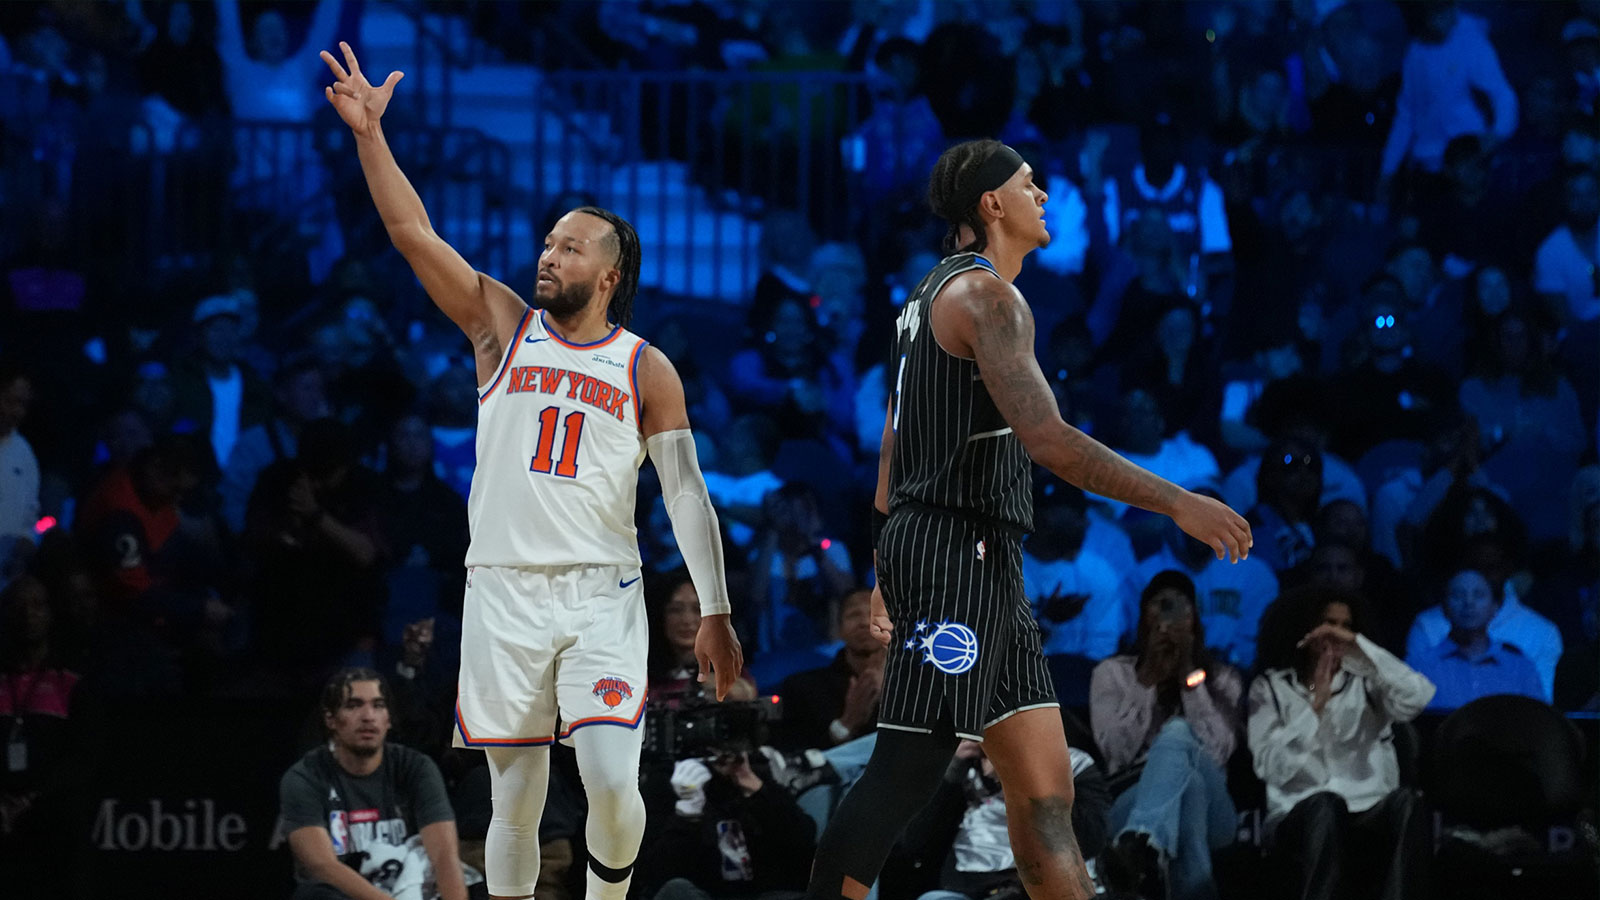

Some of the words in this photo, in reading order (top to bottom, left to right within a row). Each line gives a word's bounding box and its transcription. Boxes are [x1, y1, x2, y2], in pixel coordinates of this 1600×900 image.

[506, 366, 566, 396] NEW
[566, 370, 630, 422] YORK
[530, 405, 585, 479] 11
